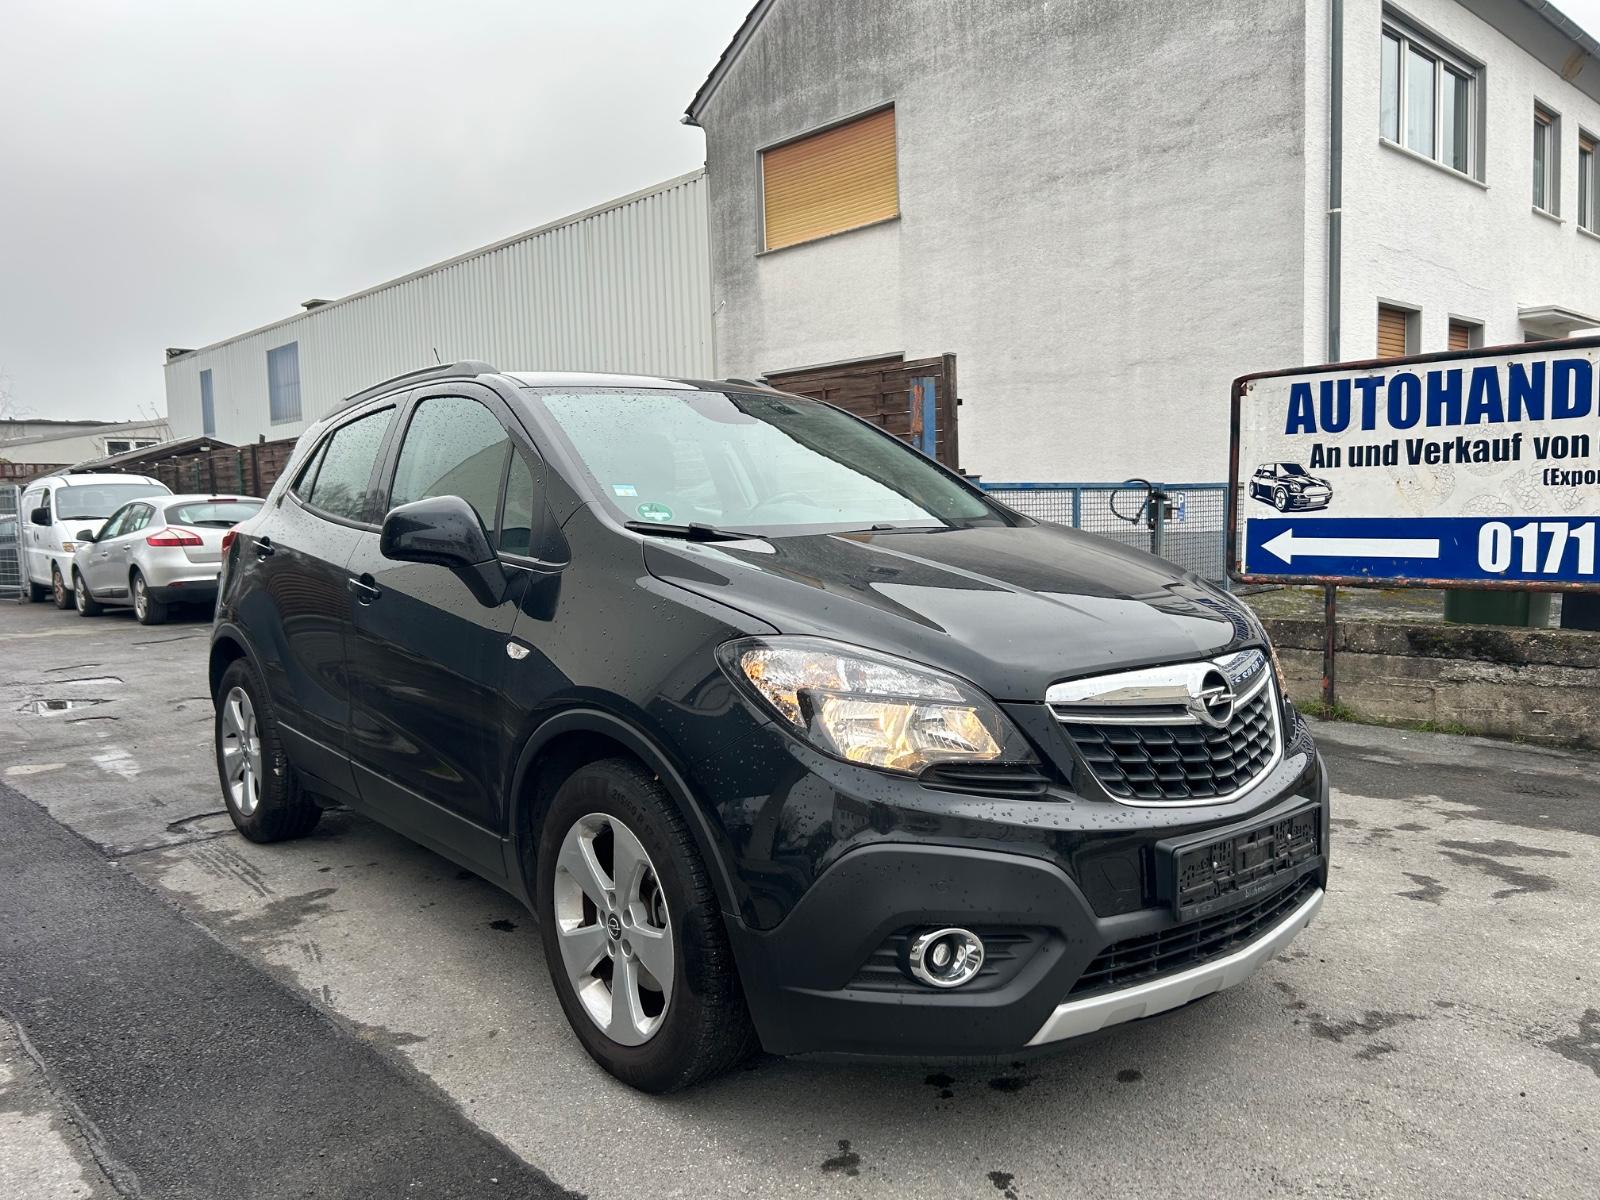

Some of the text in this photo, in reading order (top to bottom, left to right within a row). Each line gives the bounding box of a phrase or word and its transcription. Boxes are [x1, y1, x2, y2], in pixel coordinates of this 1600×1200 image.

[1285, 359, 1600, 435] AUTOHAND
[1310, 432, 1590, 469] An und Verkauf von
[1478, 521, 1595, 574] 0171
